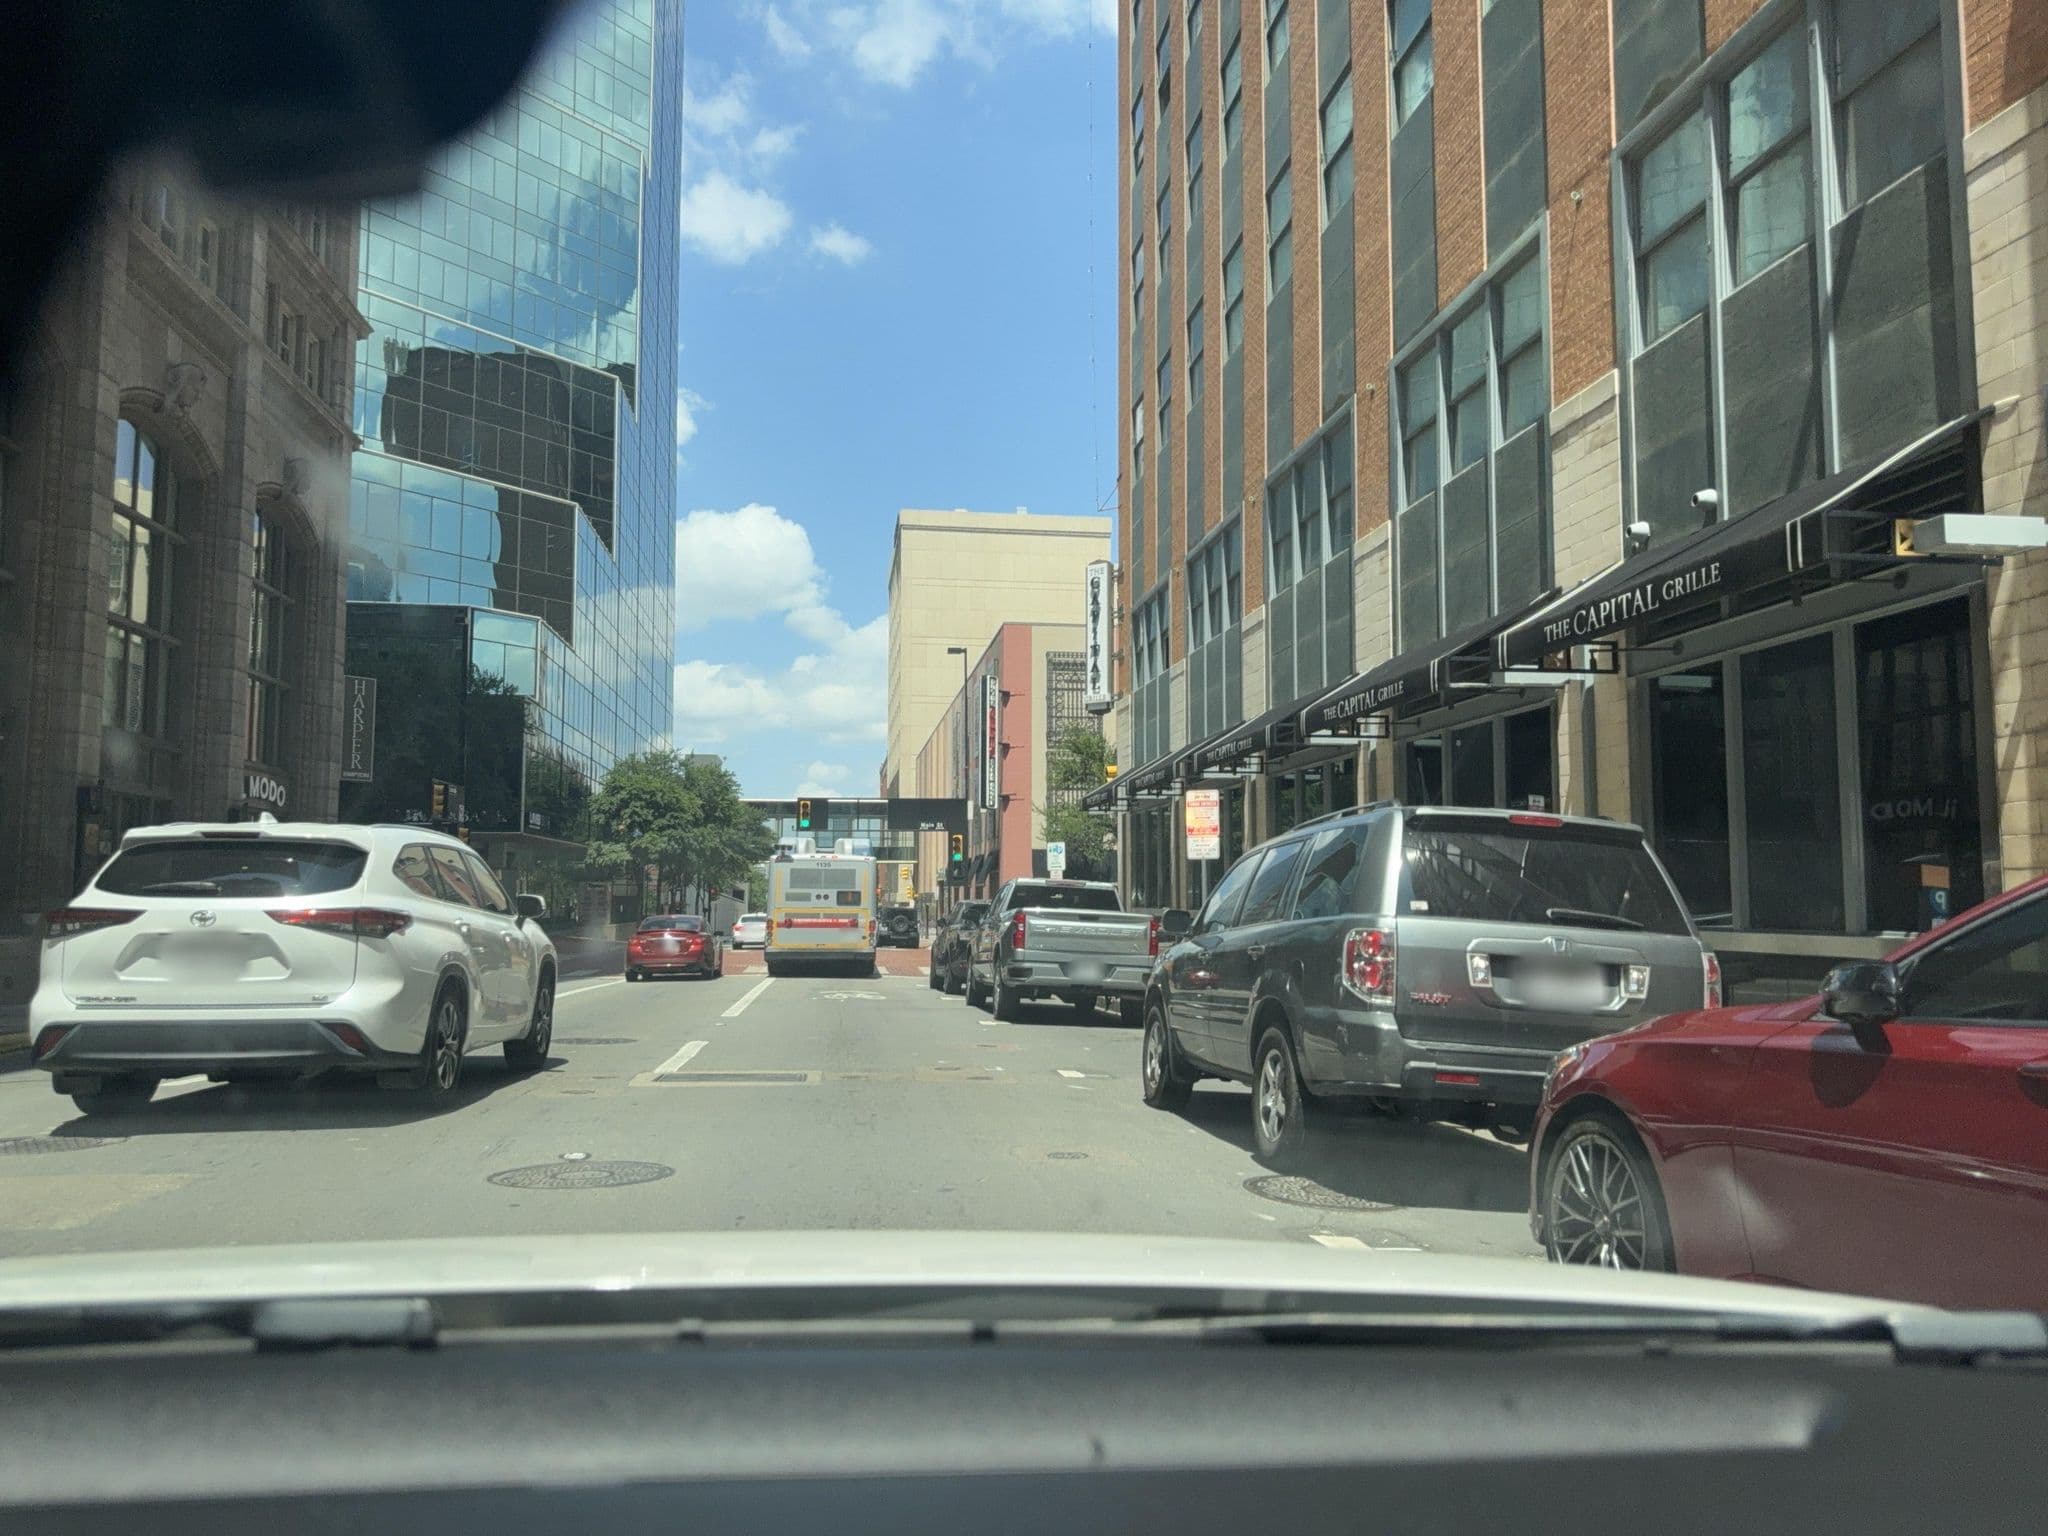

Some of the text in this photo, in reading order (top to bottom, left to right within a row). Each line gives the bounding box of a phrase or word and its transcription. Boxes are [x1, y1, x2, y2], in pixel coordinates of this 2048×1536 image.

[1089, 567, 1104, 576] THE
[1544, 562, 1721, 642] THE CAPITAL GRILLE
[1090, 576, 1101, 694] CAPITAL
[351, 679, 366, 770] HARPER
[1323, 680, 1404, 720] THE CAPITAL GRILLE
[250, 775, 286, 807] MODO
